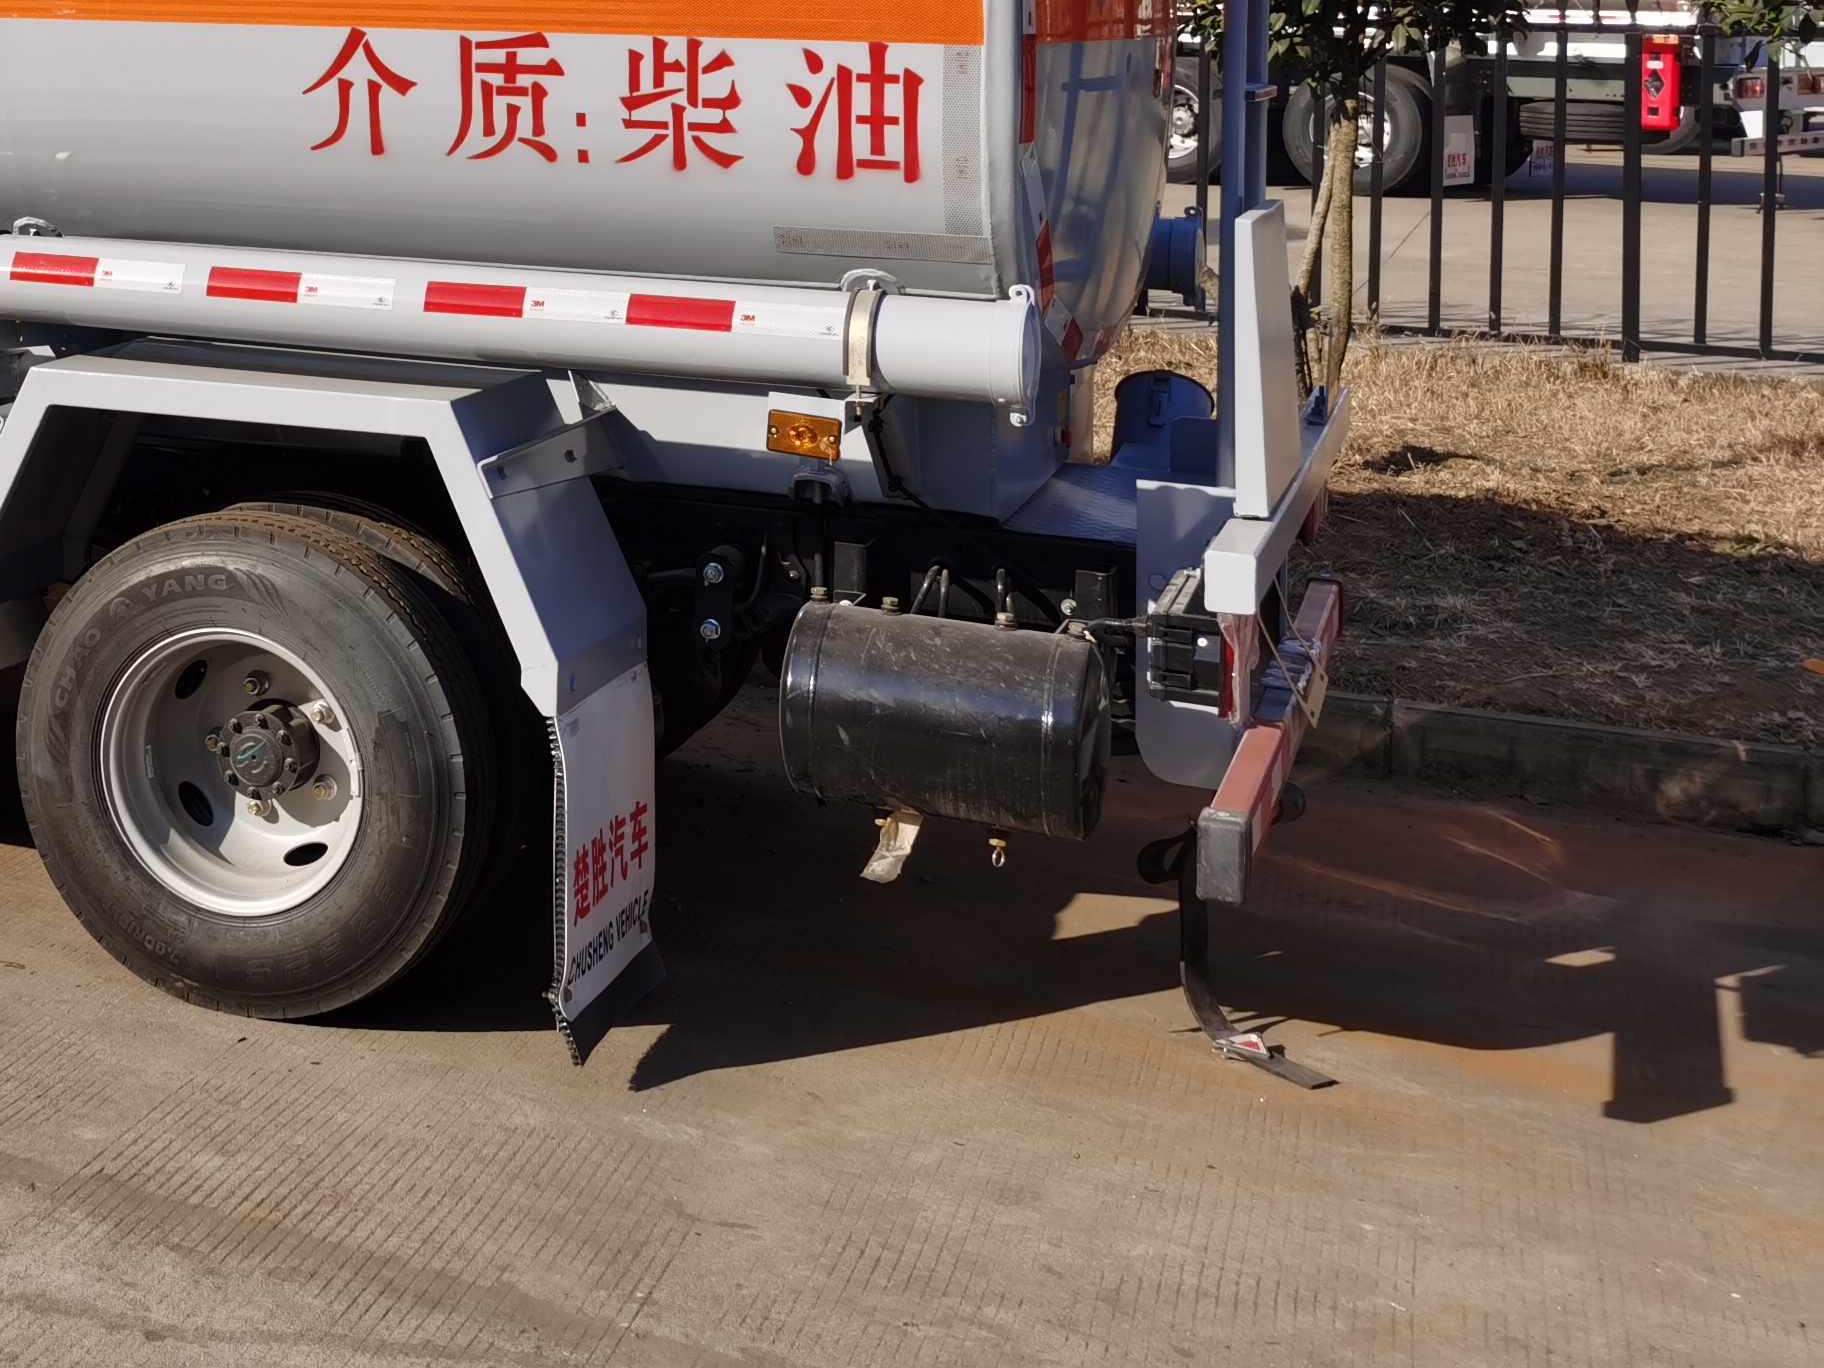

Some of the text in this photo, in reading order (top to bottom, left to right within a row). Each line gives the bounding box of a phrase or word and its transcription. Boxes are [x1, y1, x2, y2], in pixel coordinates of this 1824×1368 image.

[301, 26, 926, 184] 介质:柴油
[304, 285, 319, 294] 3M
[530, 300, 545, 308] 3M
[740, 314, 756, 322] 3M
[55, 574, 228, 709] CHAO YANG
[573, 800, 649, 927] 楚胜汽车
[567, 889, 648, 986] CHUSHENG VEHICLE
